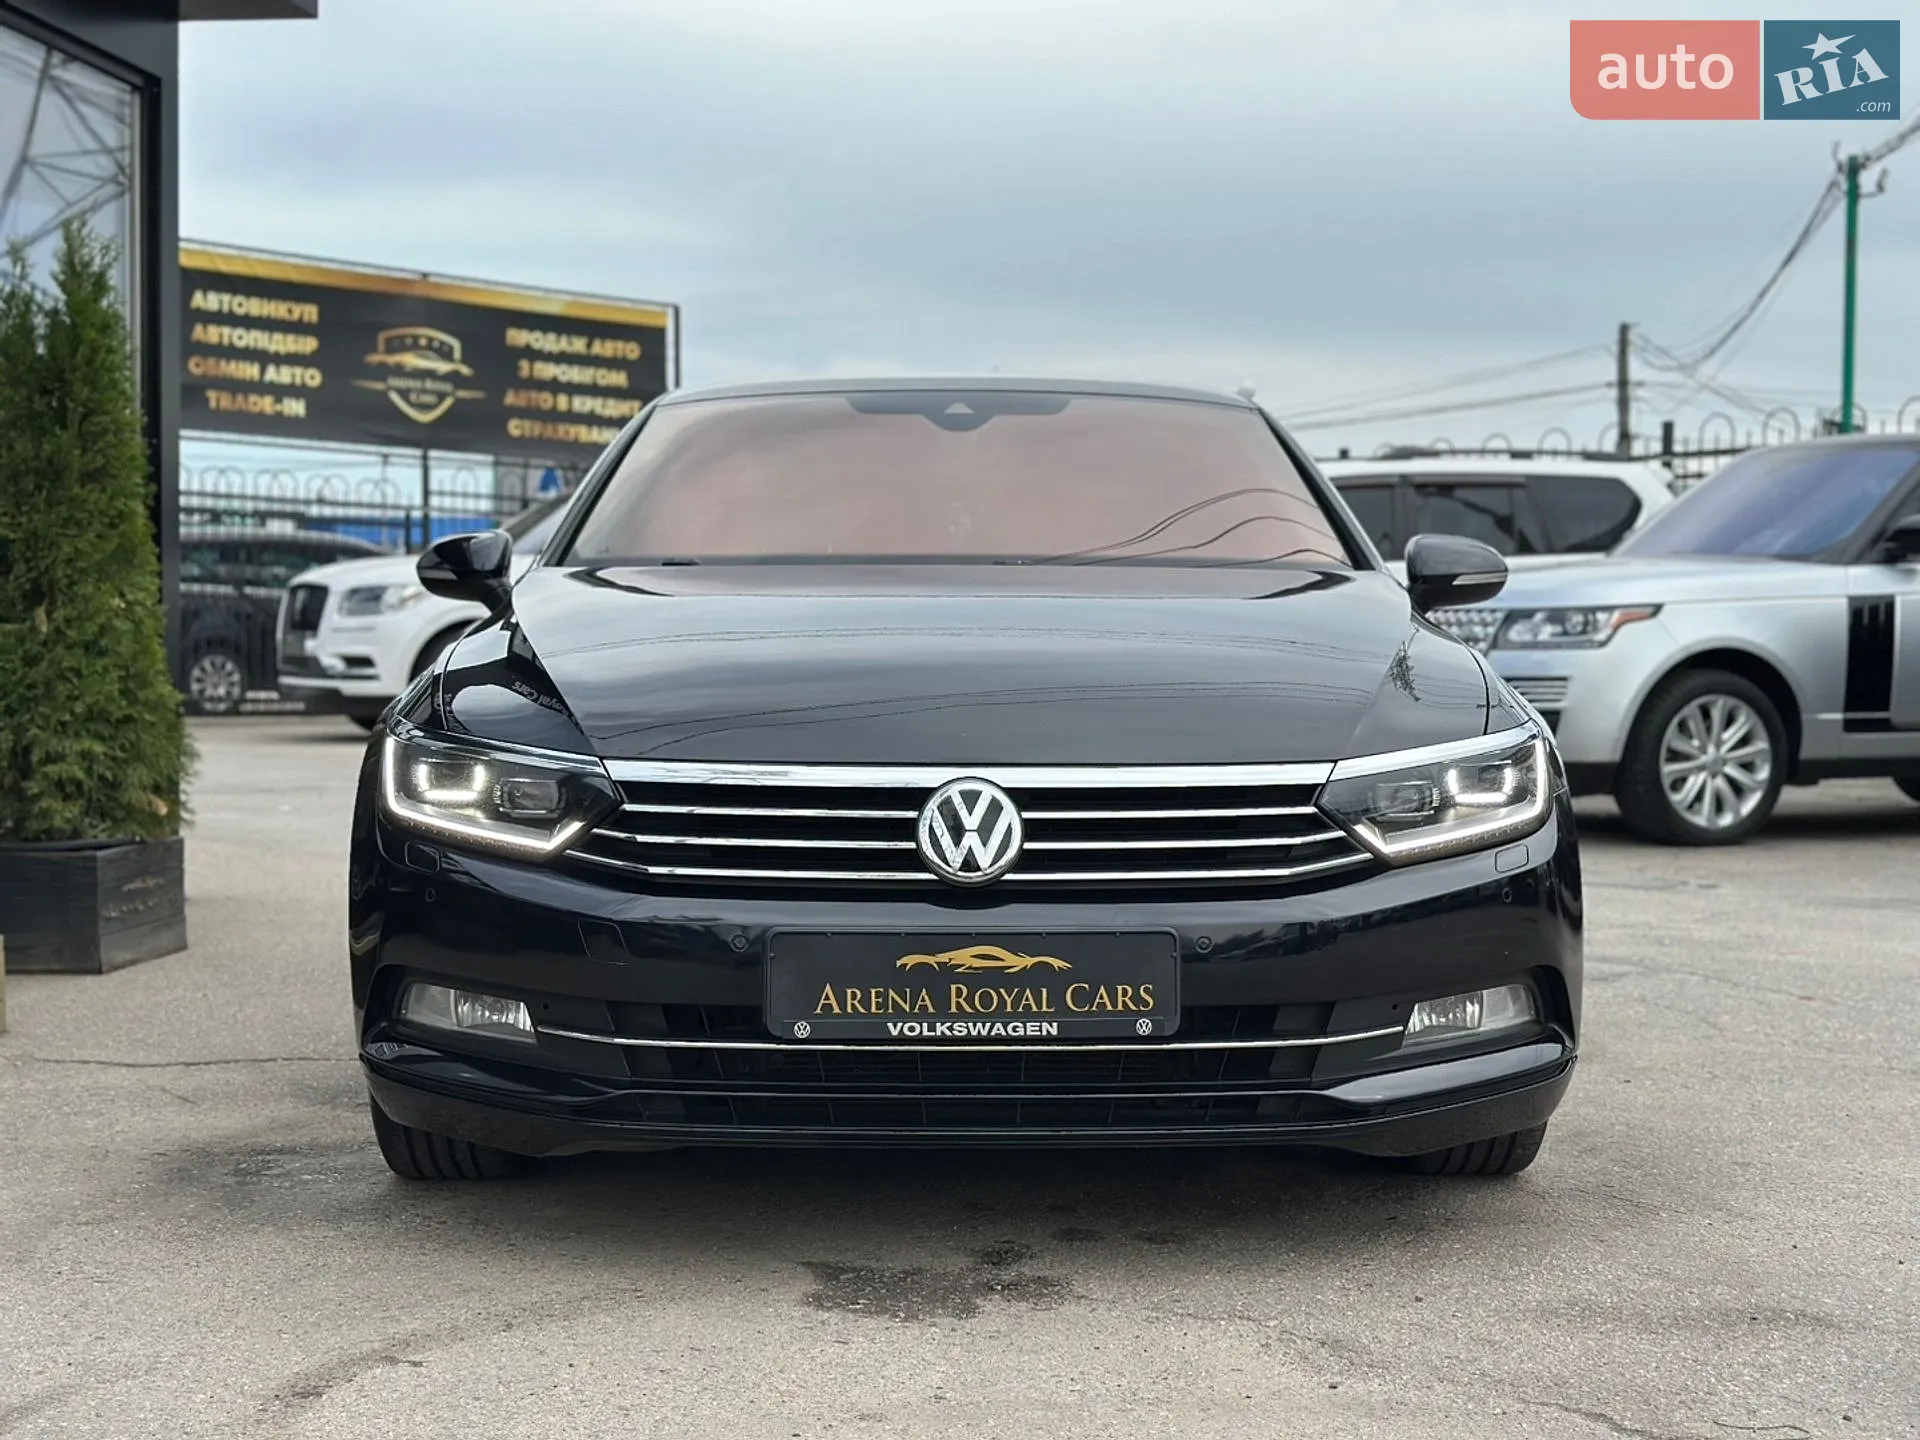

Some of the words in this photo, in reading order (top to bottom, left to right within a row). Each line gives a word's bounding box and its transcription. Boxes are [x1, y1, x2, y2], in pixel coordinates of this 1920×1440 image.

[506, 327, 588, 354] ПРОДАЖ
[591, 338, 641, 361] АВТО
[263, 362, 323, 389] АВТО
[205, 388, 307, 418] TRADE-IN
[812, 983, 936, 1015] ARENA
[949, 984, 1056, 1013] ROYAL
[1065, 983, 1154, 1012] CARS
[886, 1021, 1059, 1037] VOLKSWAGEN
